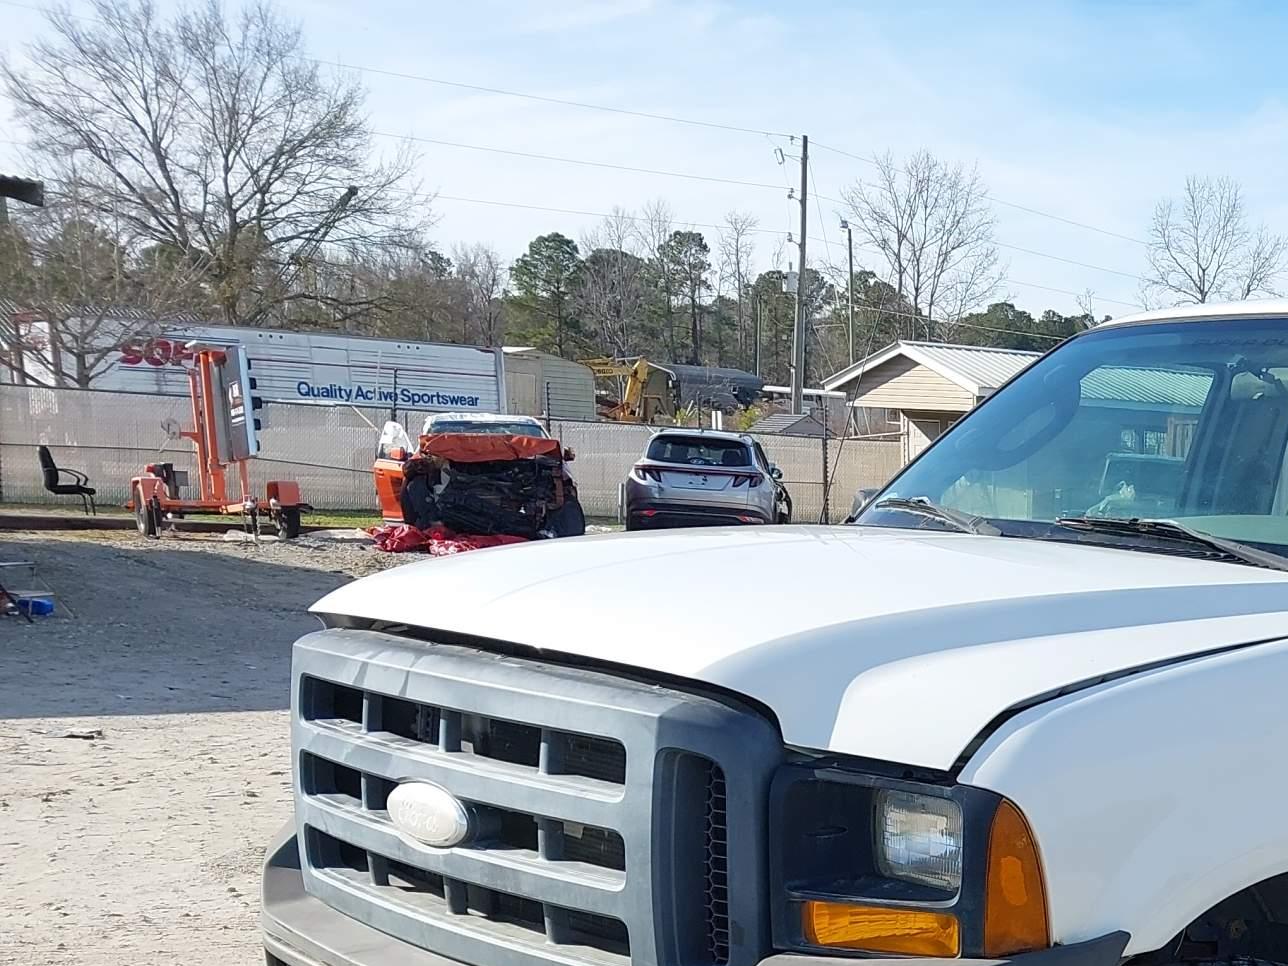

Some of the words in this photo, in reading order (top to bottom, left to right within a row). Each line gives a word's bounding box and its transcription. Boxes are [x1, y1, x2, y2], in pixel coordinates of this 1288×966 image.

[297, 381, 352, 402] Quality
[354, 385, 398, 402] Active
[400, 388, 480, 407] Sportswear
